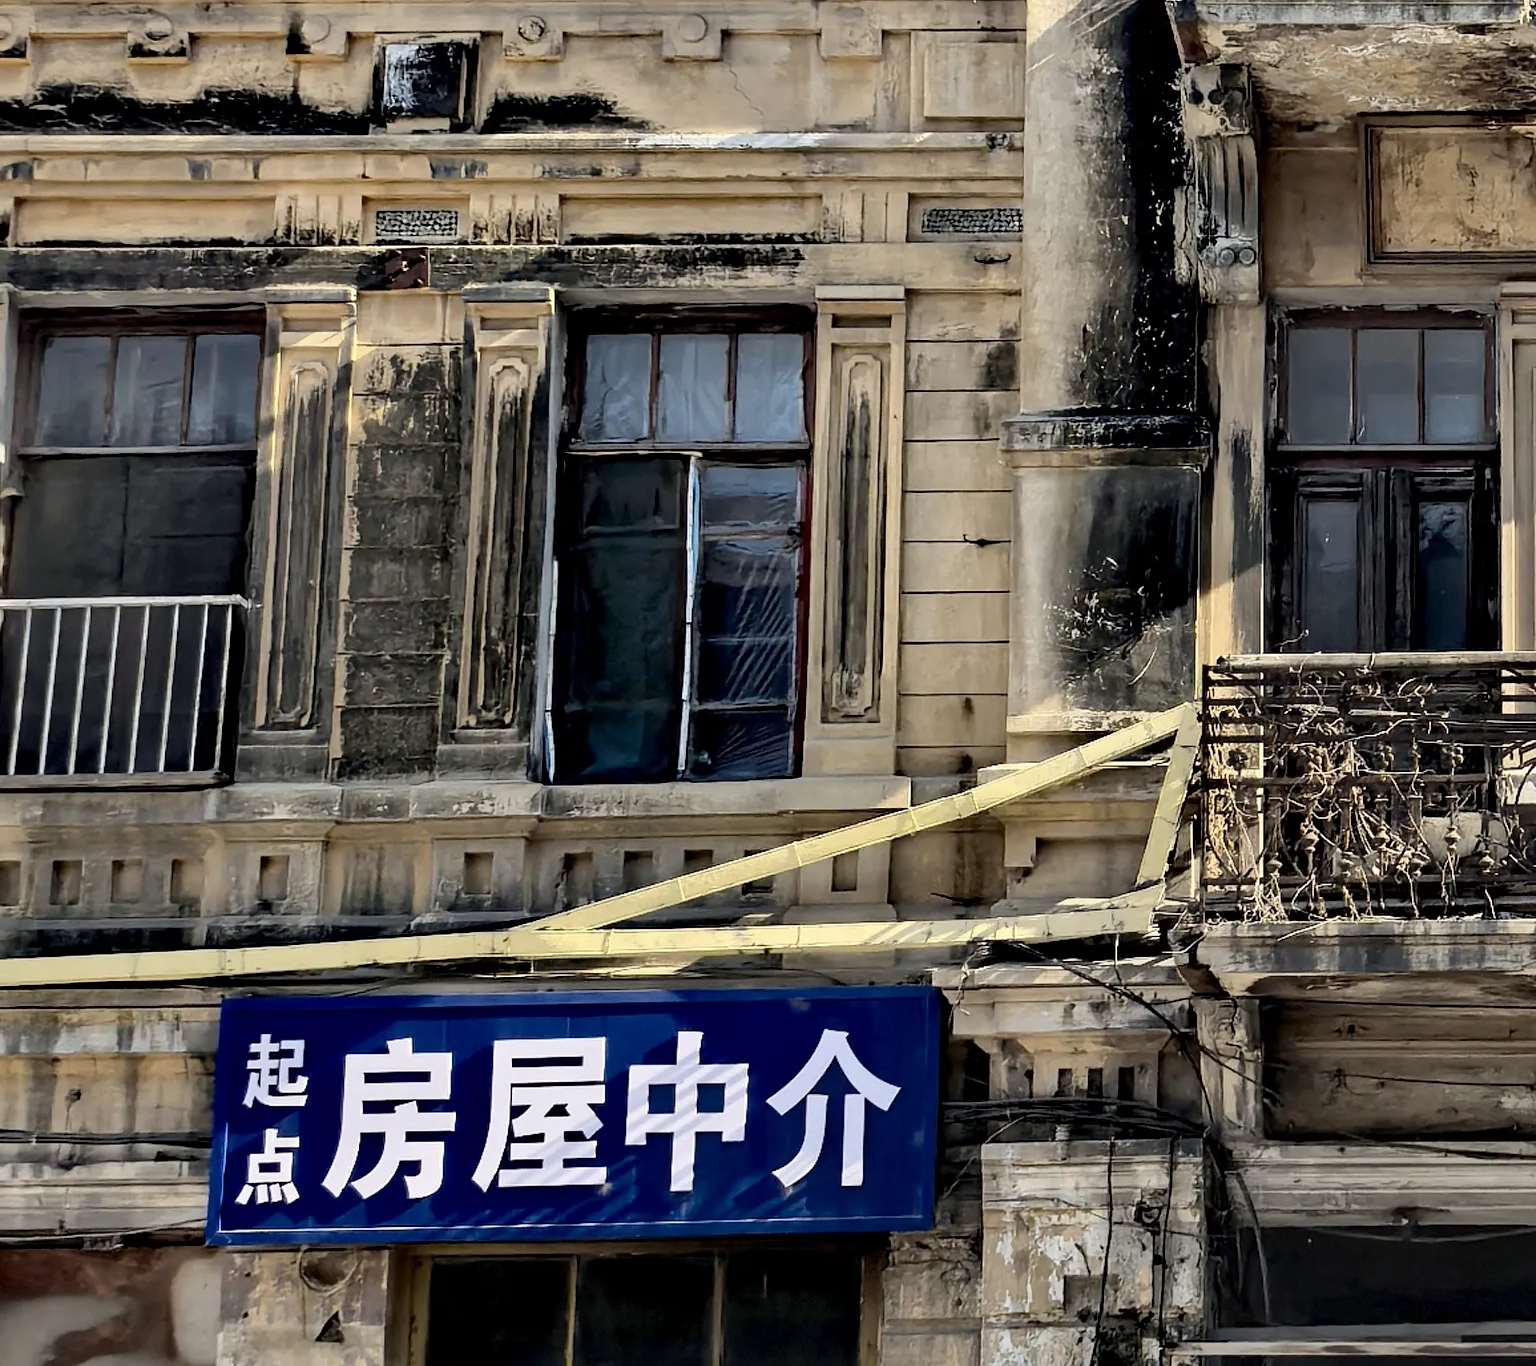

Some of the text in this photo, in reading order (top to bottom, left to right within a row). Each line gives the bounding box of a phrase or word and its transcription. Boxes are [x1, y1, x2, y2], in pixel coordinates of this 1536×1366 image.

[235, 1034, 308, 1206] 起点
[322, 1028, 901, 1198] 房屋中介
